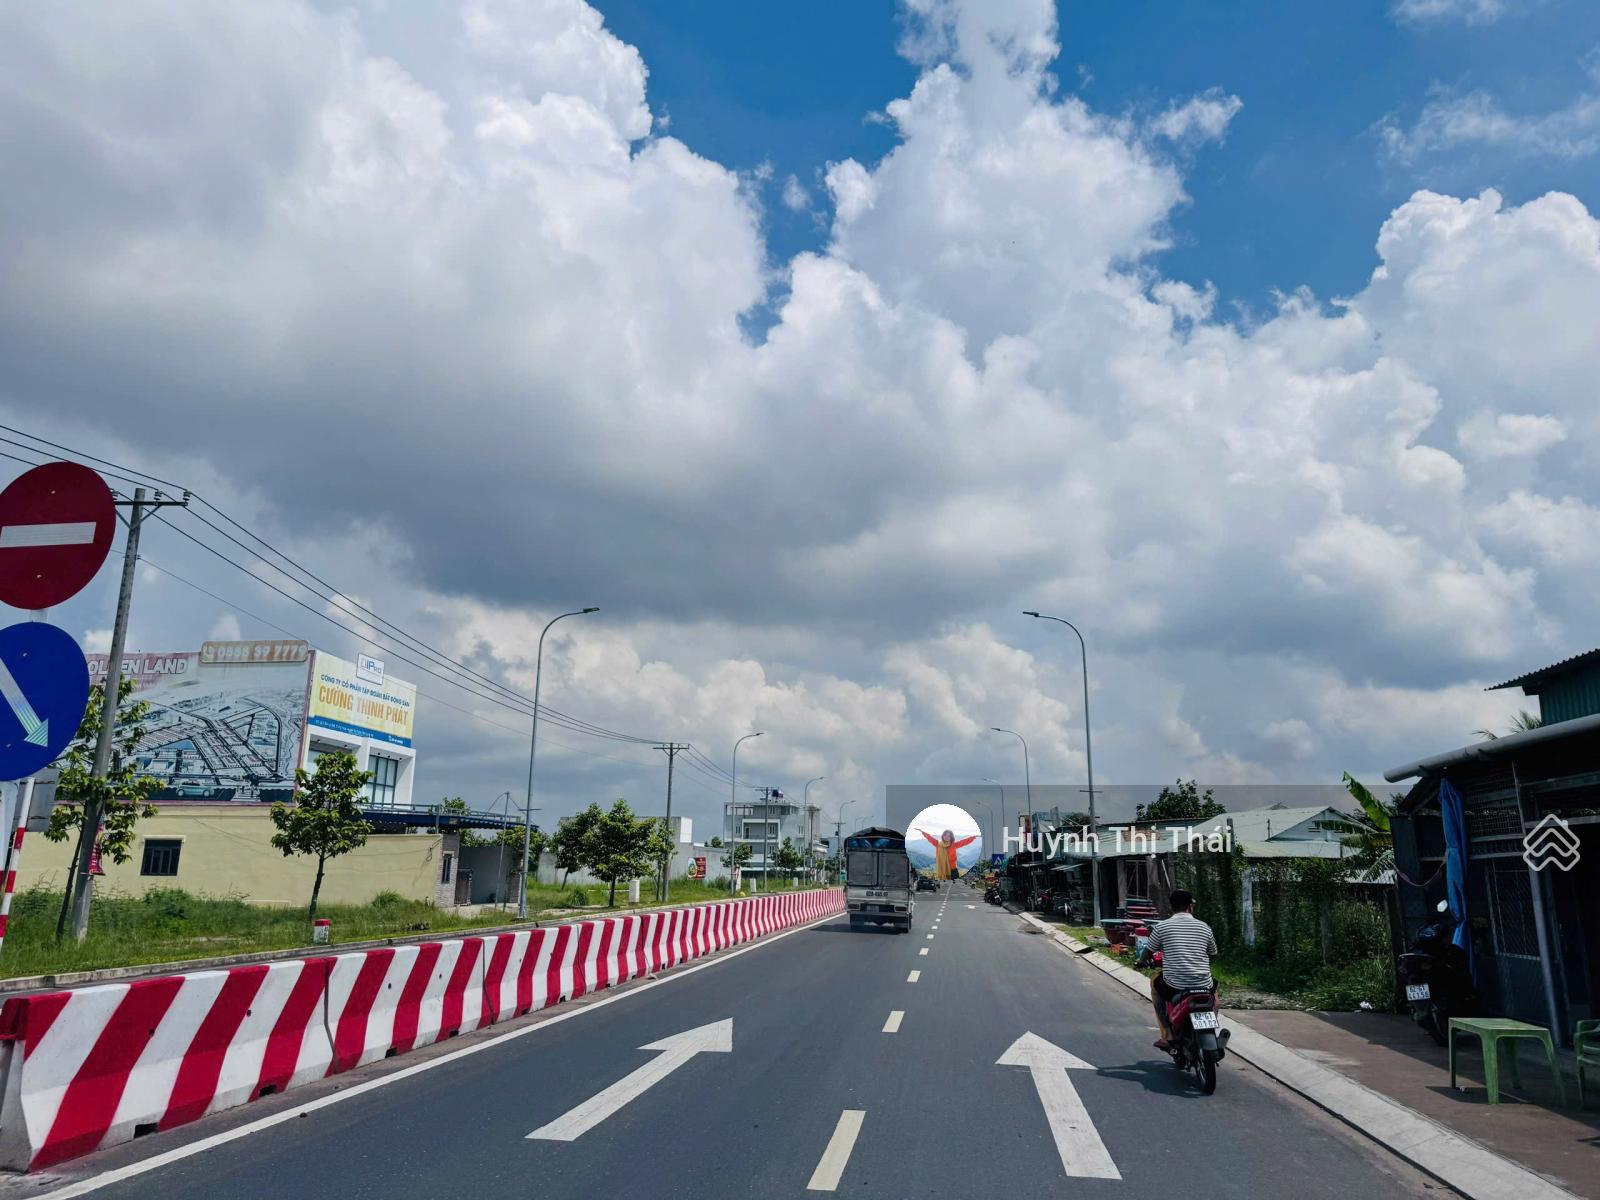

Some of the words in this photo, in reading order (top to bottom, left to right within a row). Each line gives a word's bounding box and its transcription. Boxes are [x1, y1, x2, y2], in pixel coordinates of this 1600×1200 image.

[88, 659, 140, 675] OLEN
[143, 658, 188, 674] LAND
[320, 673, 335, 684] CÔNG
[319, 686, 353, 711] CƯỜNG
[356, 697, 384, 719] THỊNH
[386, 706, 409, 726] PHÁT
